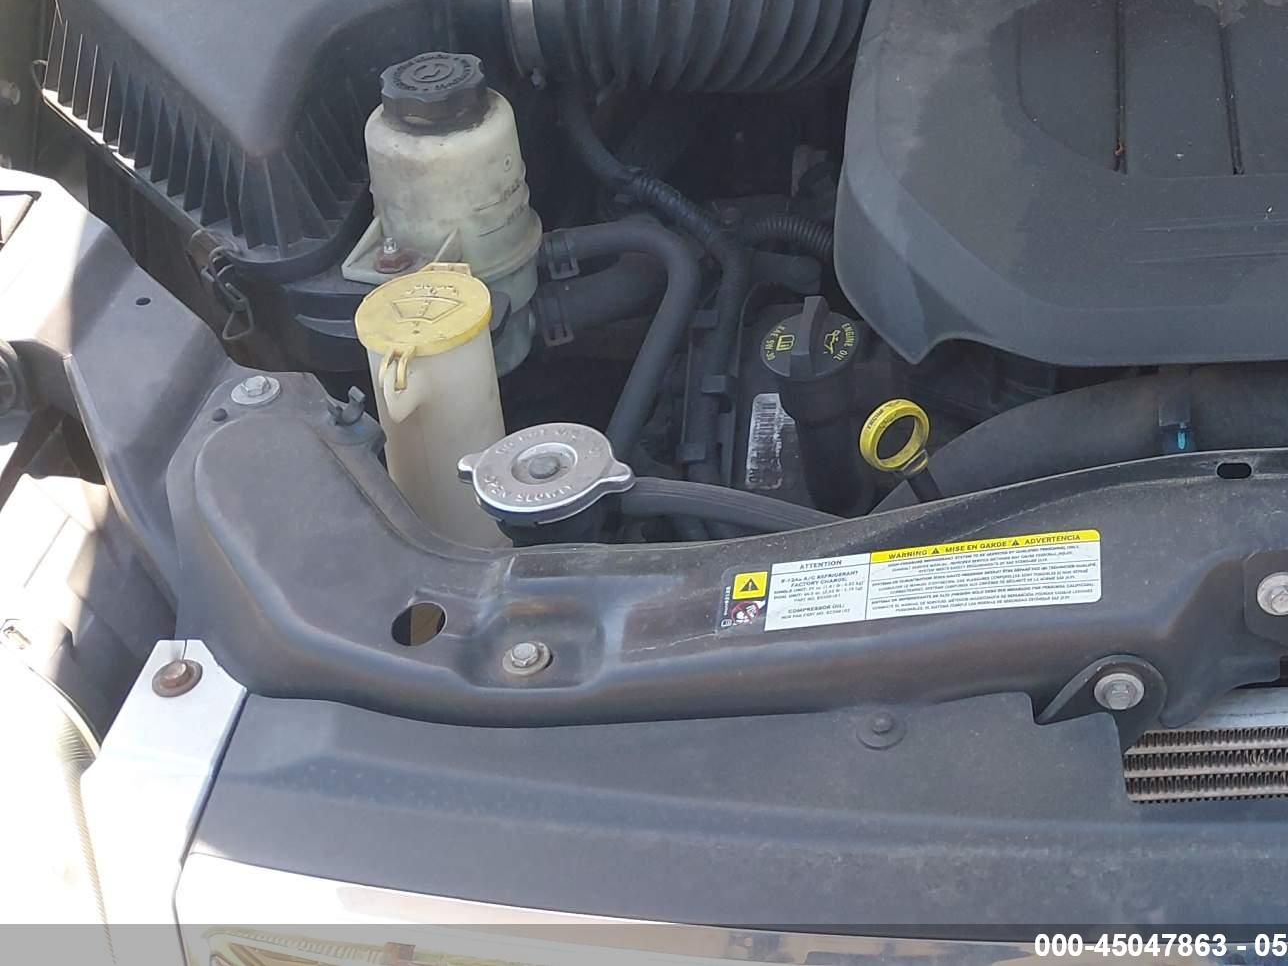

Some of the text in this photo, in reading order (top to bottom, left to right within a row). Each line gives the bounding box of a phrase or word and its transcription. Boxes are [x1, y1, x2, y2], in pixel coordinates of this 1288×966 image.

[841, 322, 855, 348] ENGINE
[833, 349, 848, 361] OIL
[888, 550, 928, 560] WARNING
[945, 544, 966, 552] MISE
[979, 540, 1007, 549] GARDE
[1024, 534, 1081, 545] ADVERTENCIA
[799, 559, 843, 570] ATTENTION
